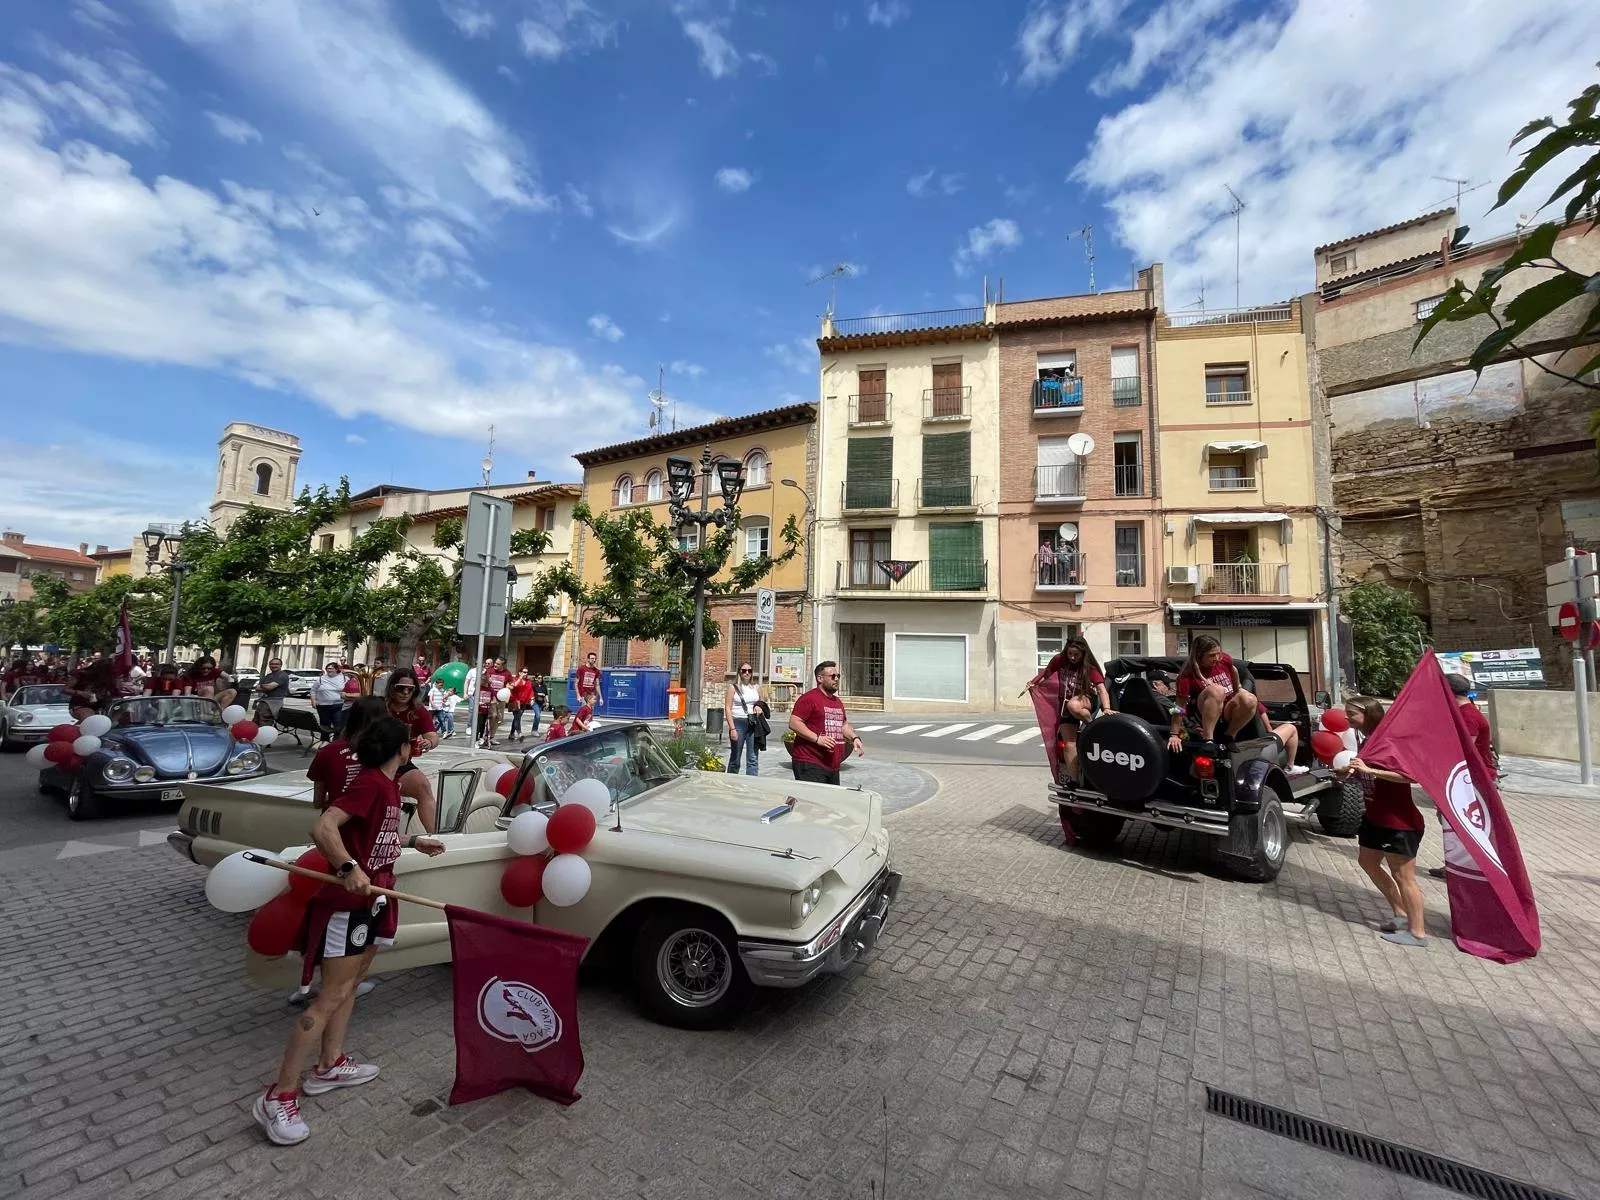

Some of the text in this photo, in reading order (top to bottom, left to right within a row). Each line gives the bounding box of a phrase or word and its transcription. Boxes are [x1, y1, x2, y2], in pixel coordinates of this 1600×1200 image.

[761, 596, 771, 607] 20
[1086, 742, 1145, 771] Jeep
[517, 990, 543, 1007] CLUB
[523, 1028, 544, 1041] AGA
